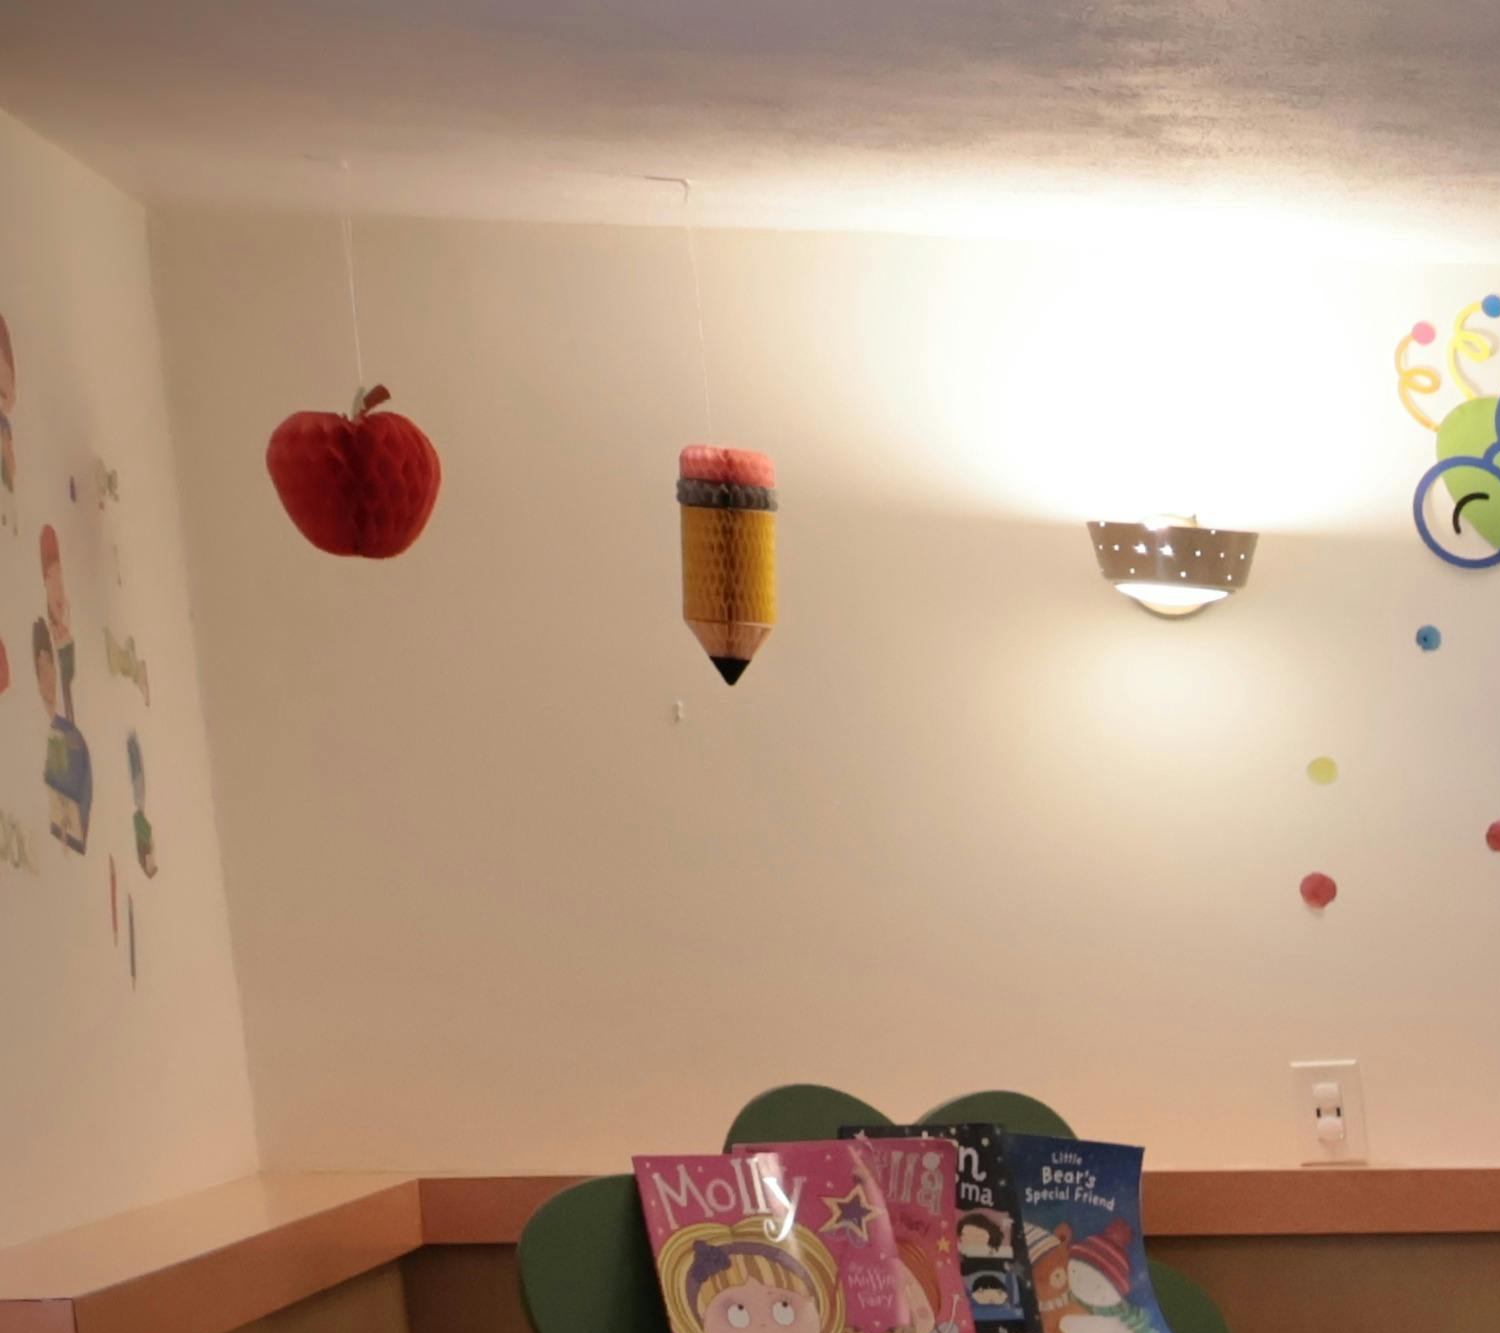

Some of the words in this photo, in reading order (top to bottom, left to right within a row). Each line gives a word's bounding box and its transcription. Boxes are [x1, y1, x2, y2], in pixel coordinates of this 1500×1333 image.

[1052, 1152, 1082, 1166] Little
[1042, 1166, 1097, 1189] Bear's
[652, 1156, 807, 1243] Molly
[1025, 1187, 1069, 1207] Special
[1074, 1187, 1115, 1212] Friend
